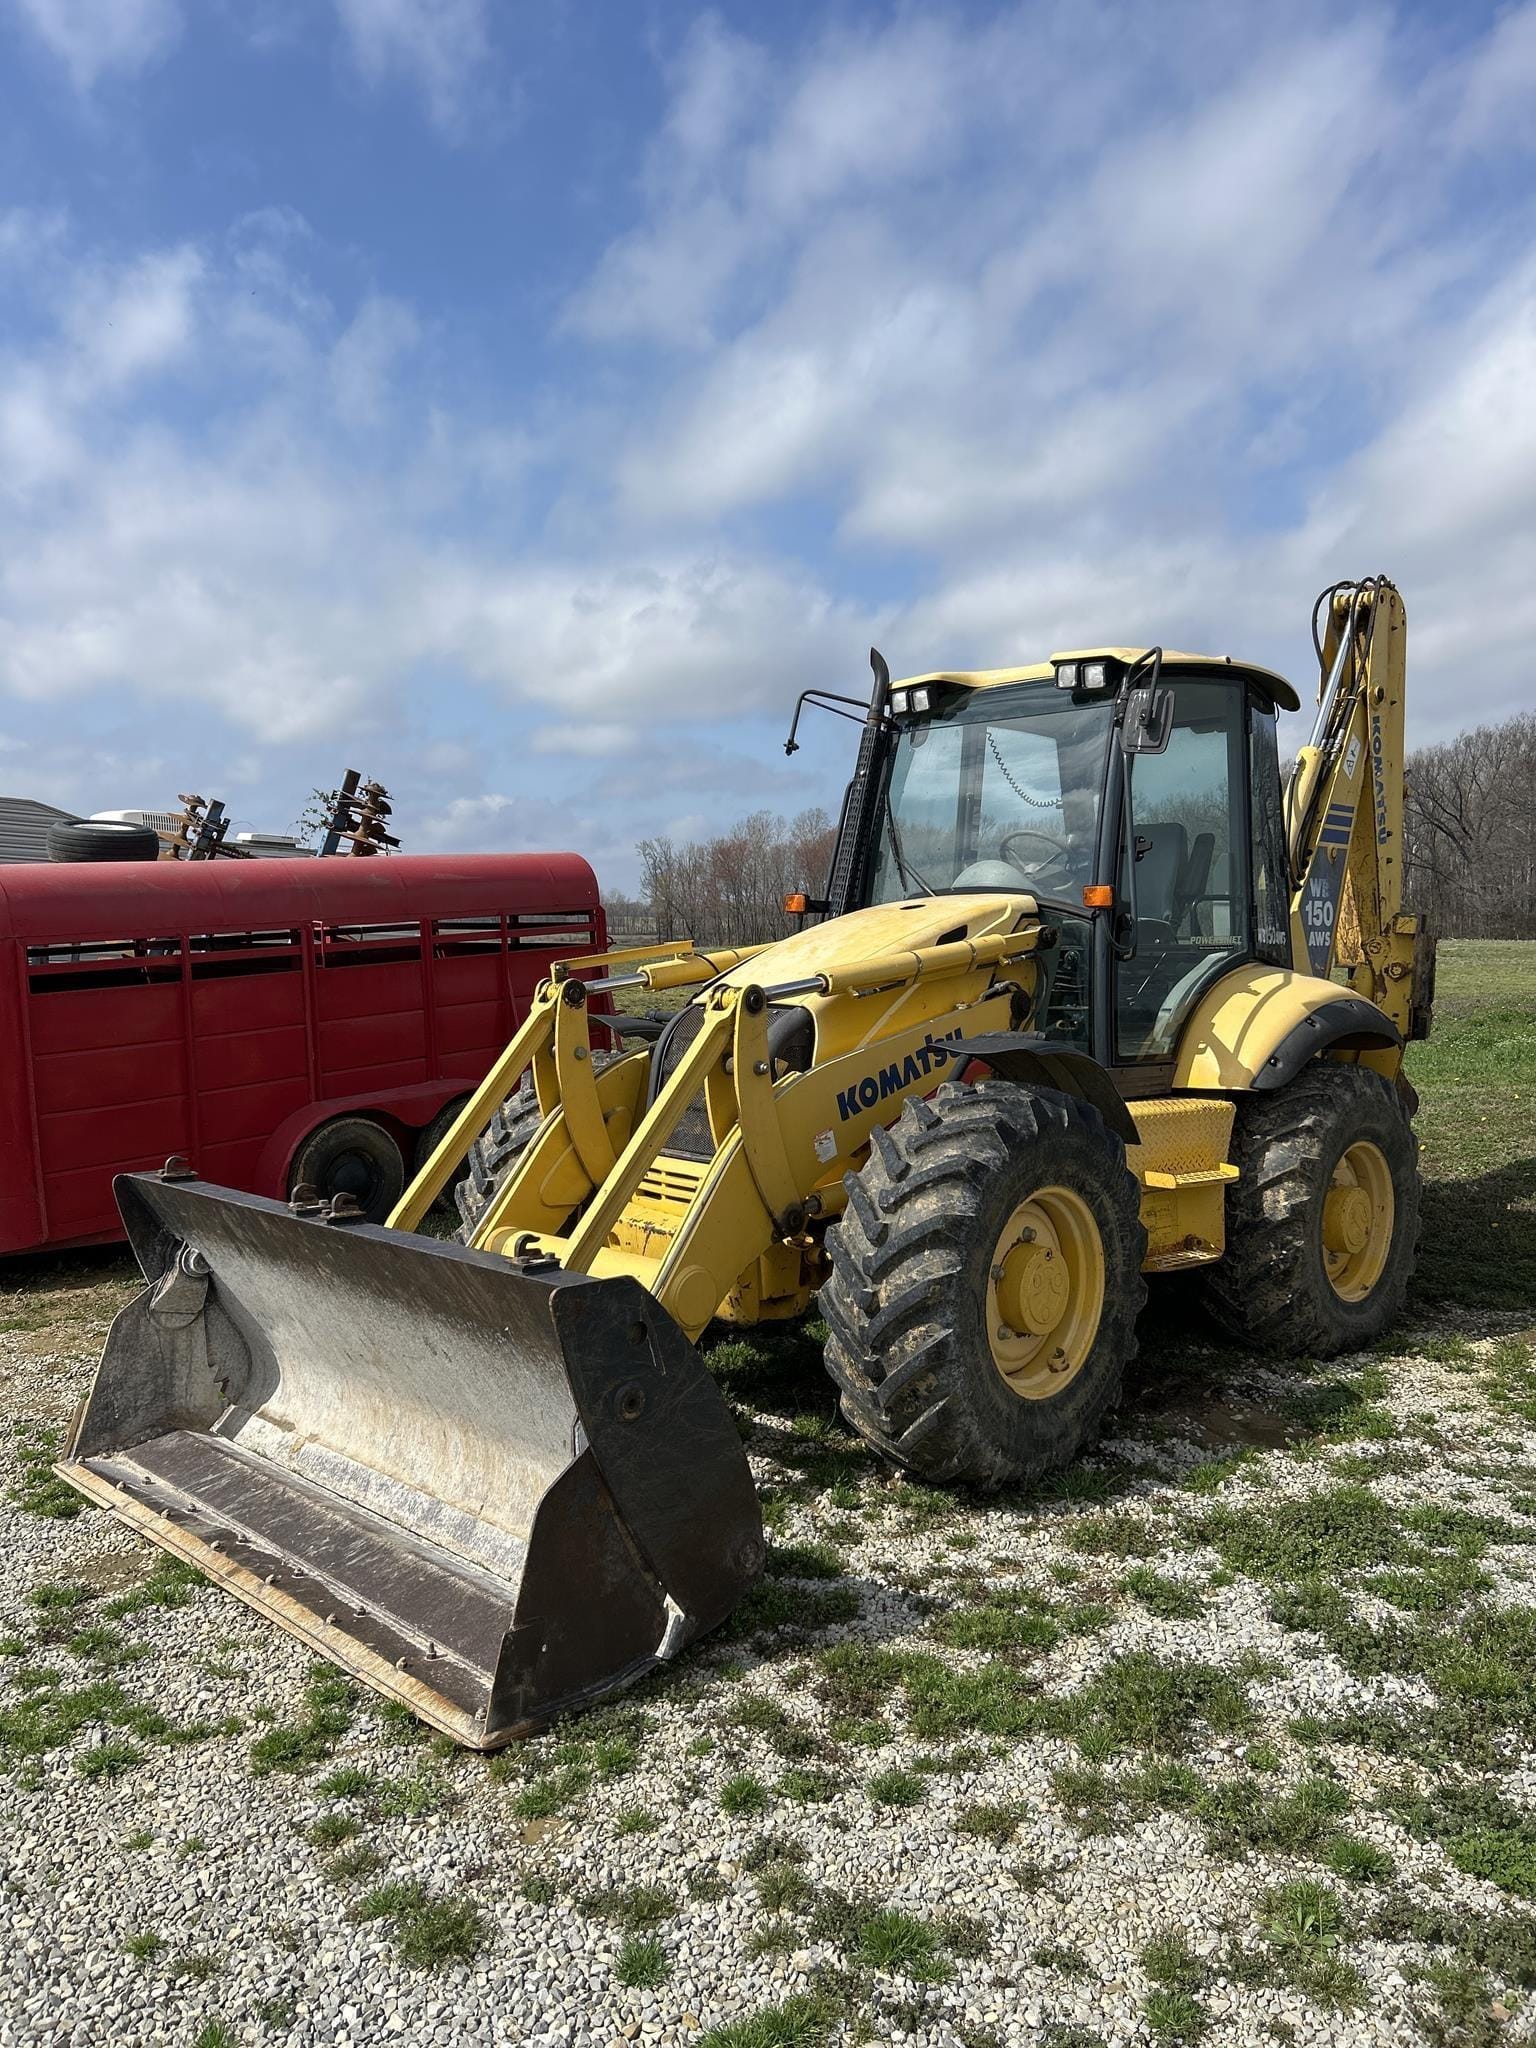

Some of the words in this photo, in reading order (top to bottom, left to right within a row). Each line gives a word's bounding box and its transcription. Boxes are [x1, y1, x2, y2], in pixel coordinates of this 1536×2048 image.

[1372, 715, 1388, 845] KOMATSU
[1305, 900, 1334, 927] 150
[1308, 931, 1331, 947] AWS
